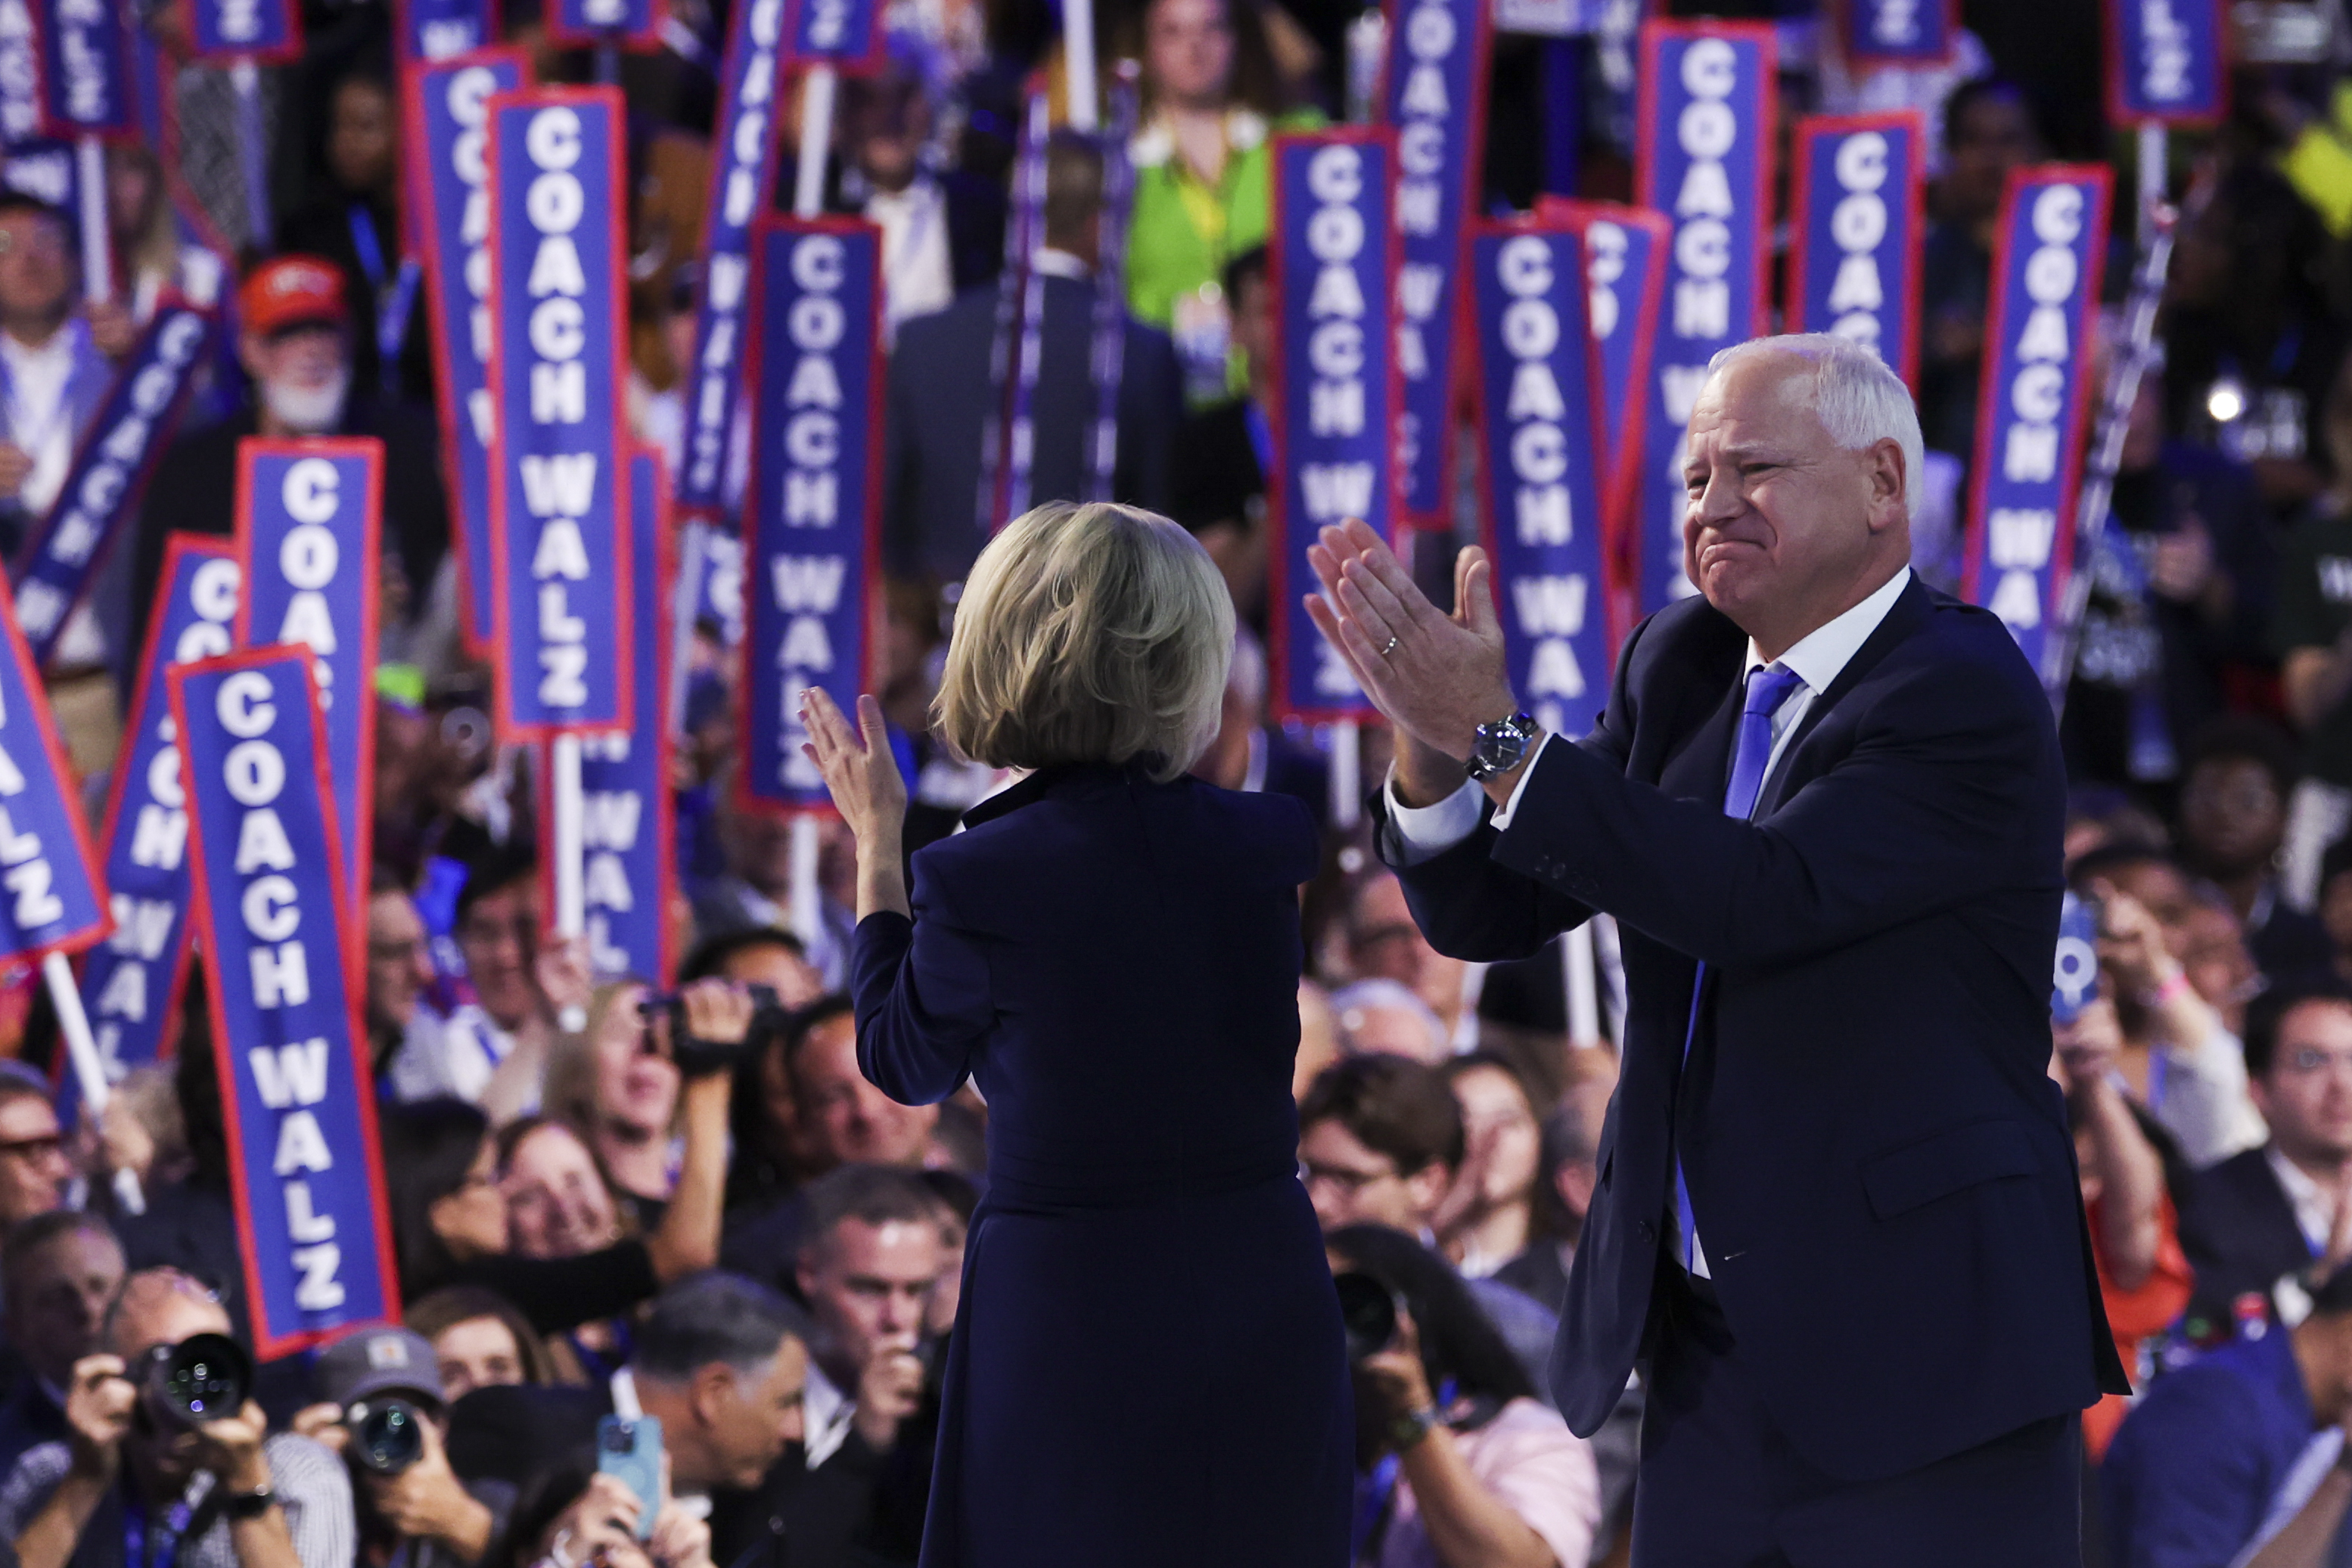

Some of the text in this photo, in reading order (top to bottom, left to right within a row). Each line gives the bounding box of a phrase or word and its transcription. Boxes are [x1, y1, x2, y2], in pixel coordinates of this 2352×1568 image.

[1307, 143, 1367, 437] COACH
[1673, 36, 1737, 340] COACH
[519, 104, 597, 708] COACH WALZ
[782, 234, 846, 529] COACH
[1496, 234, 1587, 741] COACH WAL
[1987, 182, 2084, 643] COACH WA
[279, 456, 340, 713] COA
[94, 891, 176, 1084] WAL
[216, 670, 345, 1312] COACH WALZ
